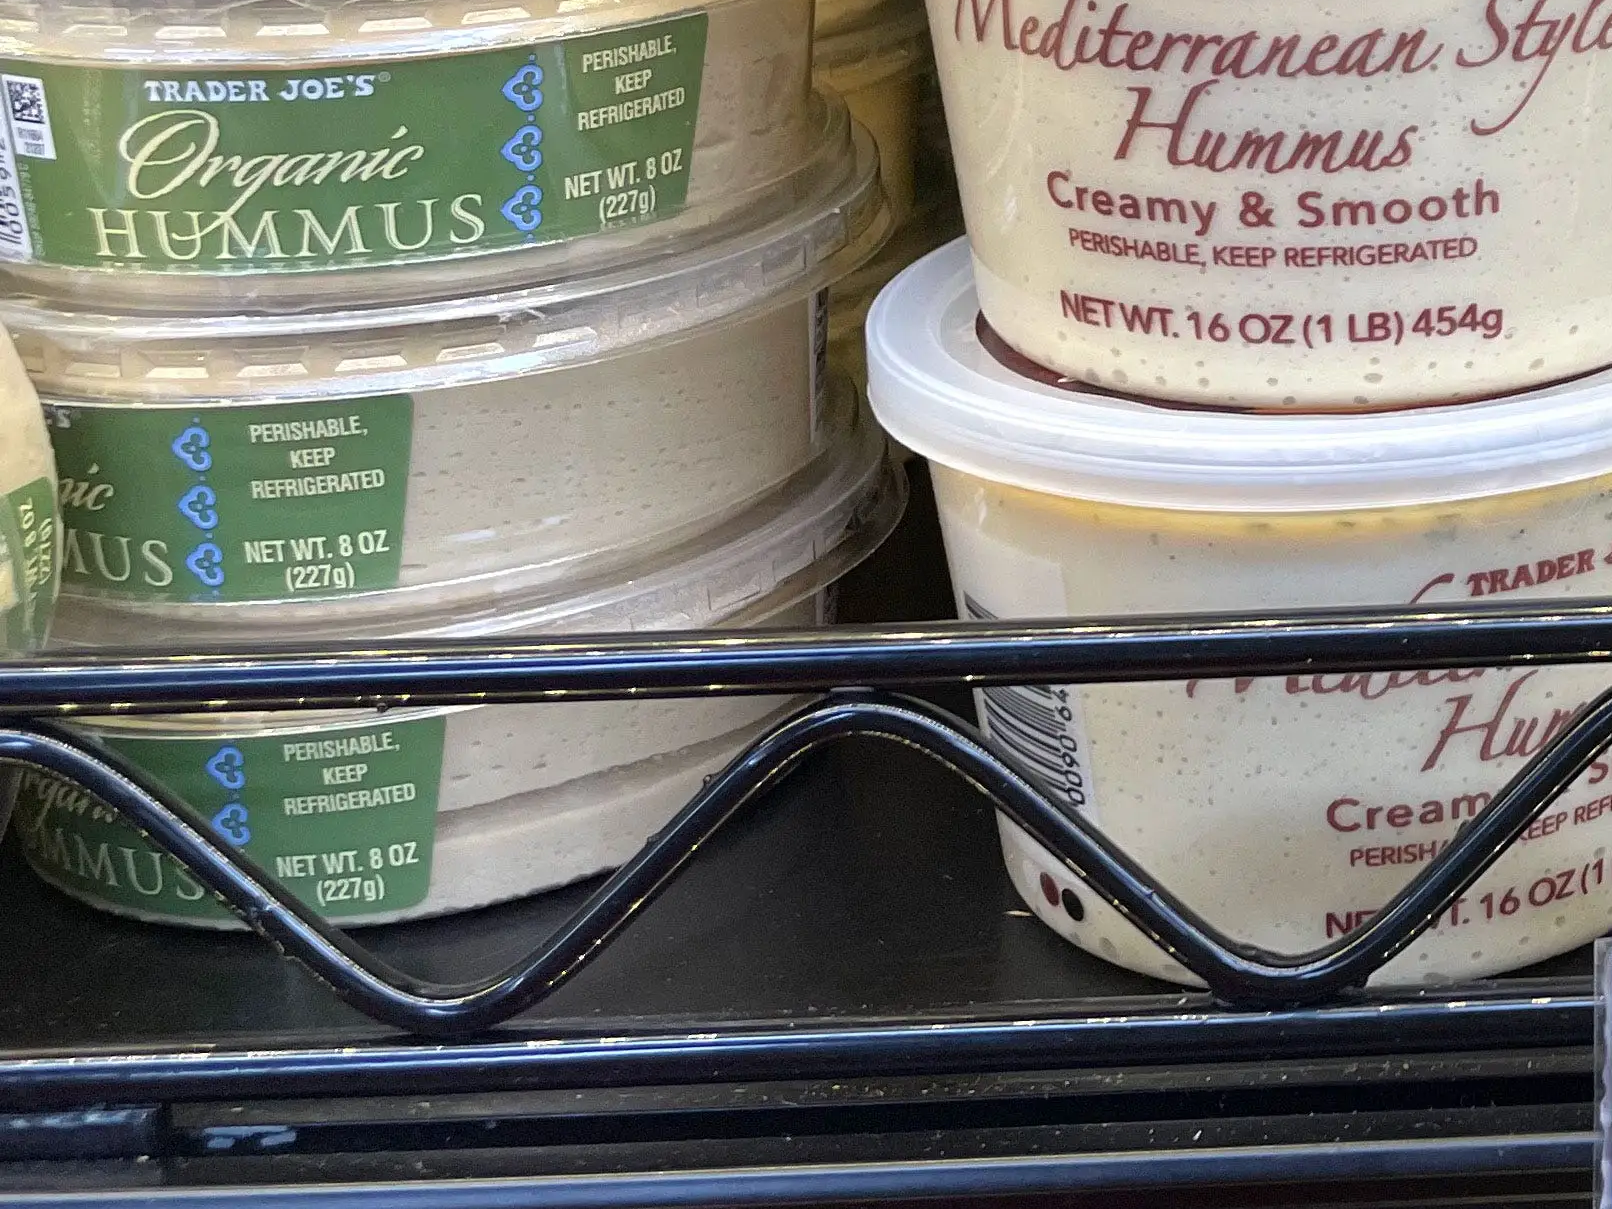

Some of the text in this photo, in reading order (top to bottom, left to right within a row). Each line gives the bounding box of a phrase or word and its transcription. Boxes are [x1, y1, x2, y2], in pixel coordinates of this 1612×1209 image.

[582, 34, 678, 72] PERISHABLE,
[145, 76, 269, 103] TRADER
[614, 67, 652, 94] KEEP
[576, 86, 686, 133] REFRIGERATED
[1113, 78, 1417, 174] Hummus
[119, 108, 424, 240] Organic
[564, 148, 683, 200] NET WT. 8 OZ
[599, 186, 657, 225] (227g)
[1046, 171, 1500, 236] Creamy & Smooth
[87, 193, 486, 262] HUMMUS
[1068, 228, 1478, 269] PERISHABLE, KEEP REFRIGERATED
[1060, 290, 1114, 327] NET
[1119, 303, 1180, 339] WT.
[1187, 313, 1233, 343] 16
[249, 416, 368, 443] PERISHABLE,
[290, 448, 335, 469] KEEP
[251, 470, 386, 500] REFRIGERATED
[244, 529, 390, 564] NET WT. 8 OZ
[286, 562, 356, 592] (227g)
[1467, 547, 1595, 596] TRADER
[283, 732, 400, 762] PERISHABLE,
[323, 763, 368, 785] KEEP
[284, 783, 416, 816] REFRIGERATED
[276, 841, 420, 878] NET WT. 8 OZ
[317, 875, 386, 907] (227g)
[1480, 886, 1521, 919] 16
